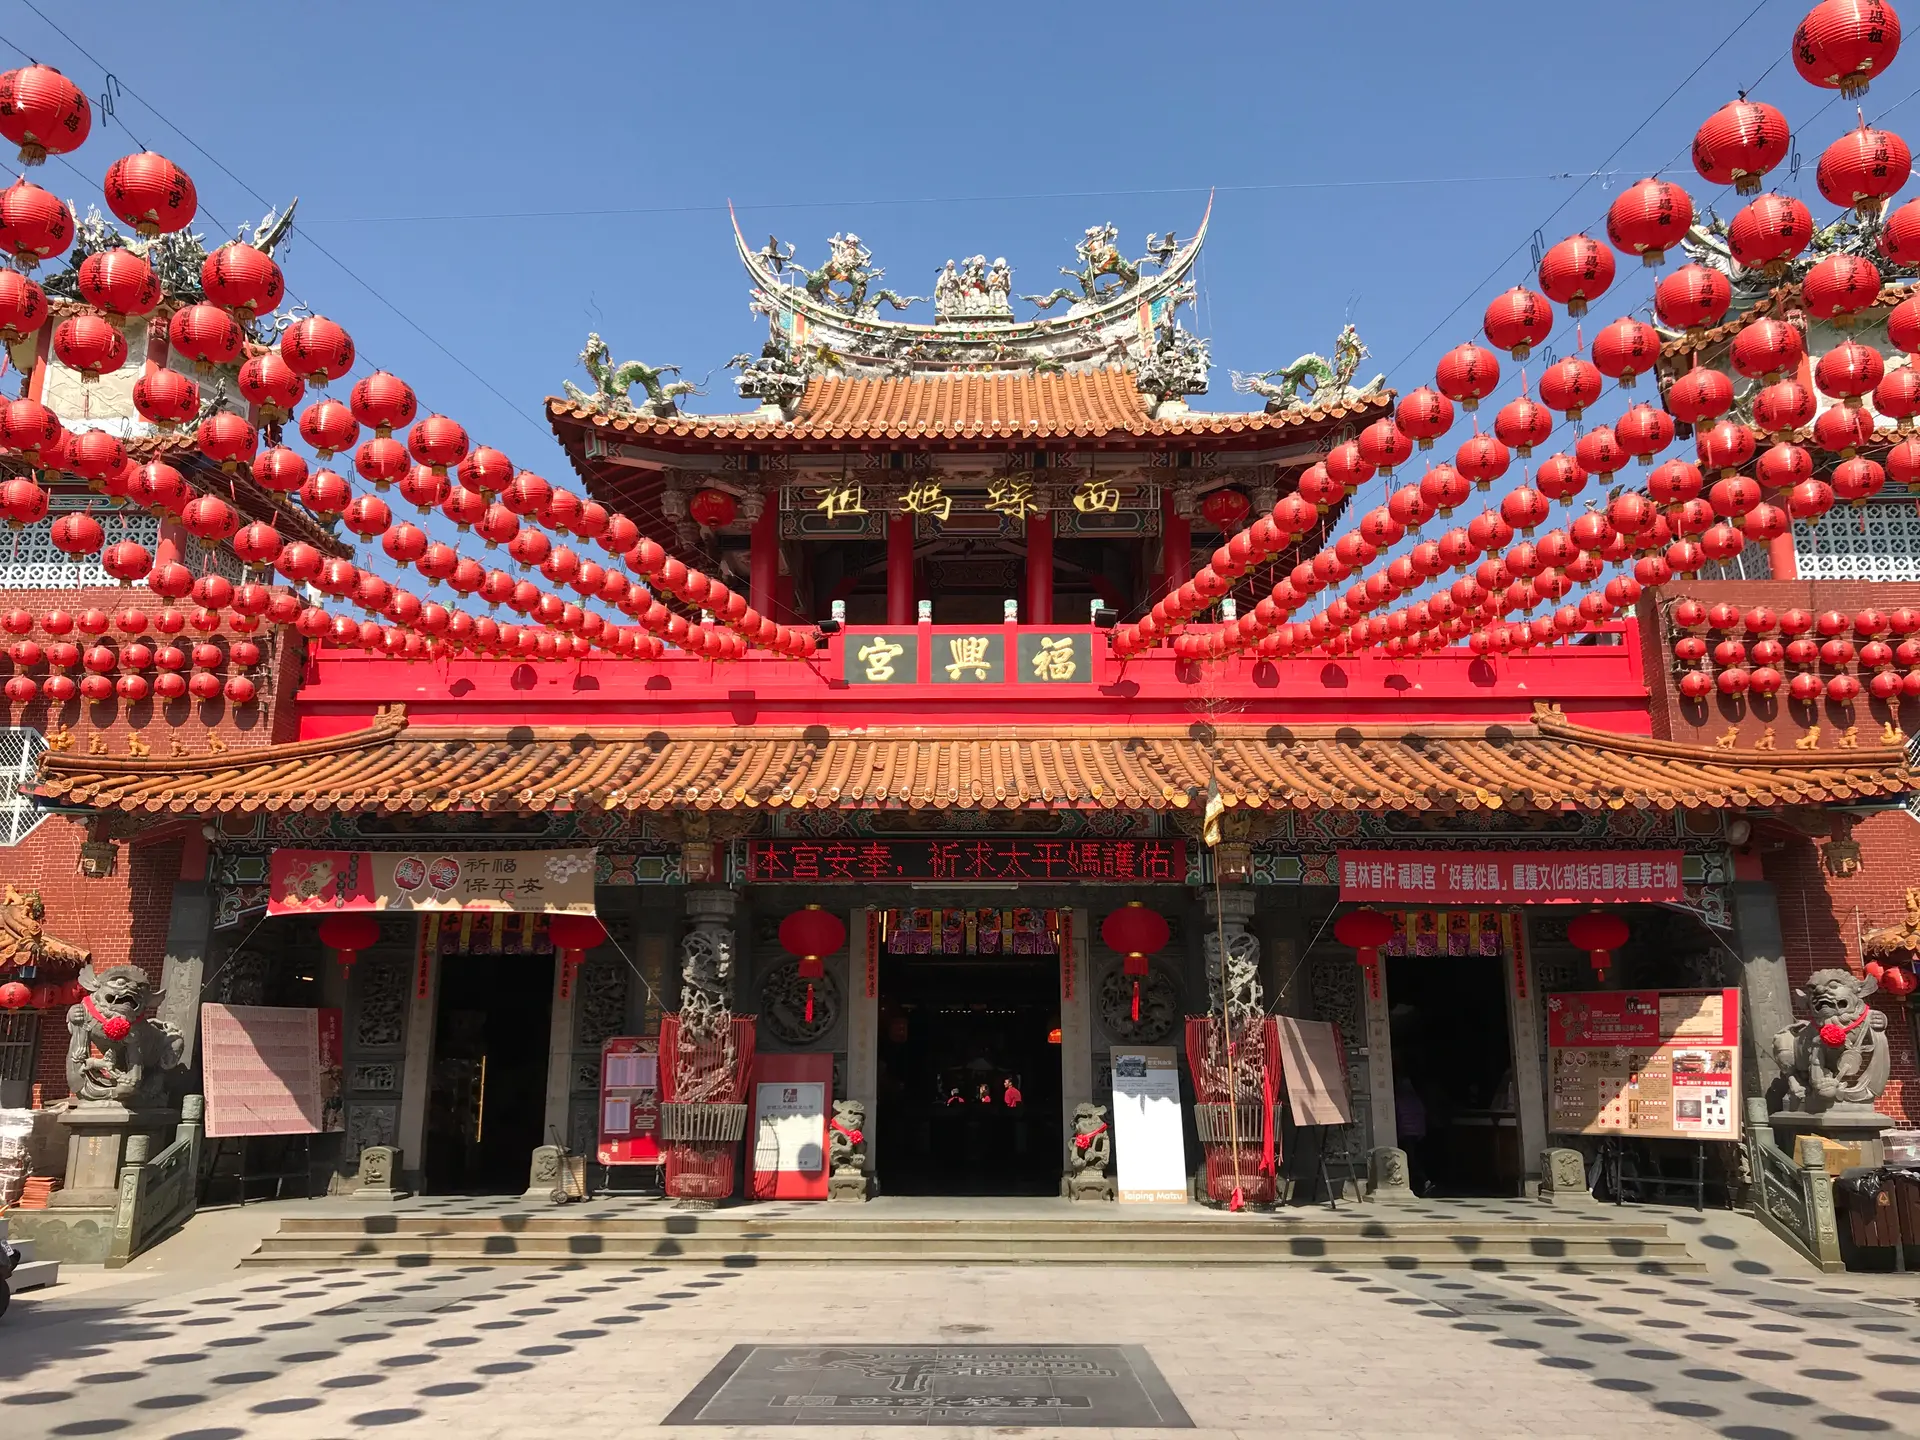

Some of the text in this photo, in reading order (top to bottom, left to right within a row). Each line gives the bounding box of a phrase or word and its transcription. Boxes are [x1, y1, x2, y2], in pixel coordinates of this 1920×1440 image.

[815, 475, 1121, 522] 西螺媽祖
[857, 635, 1077, 683] 福興宮
[464, 857, 517, 874] 祈福
[1344, 860, 1395, 890] 雲林首件
[462, 877, 545, 898] 保平安
[1123, 1190, 1184, 1203] Taiping Matzu
[887, 1409, 980, 1417] 1717
